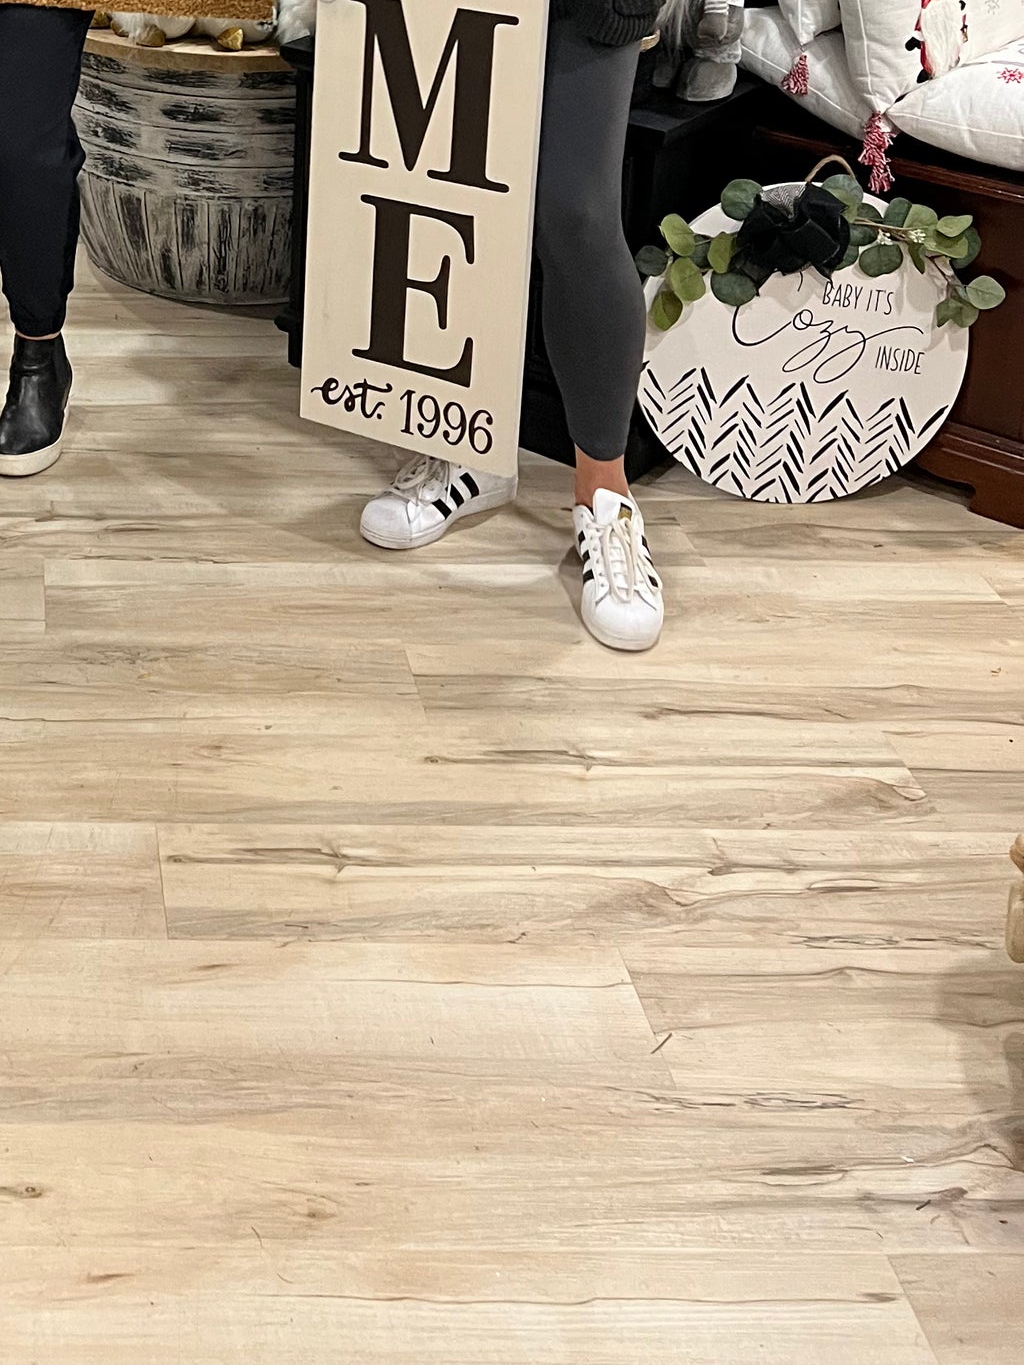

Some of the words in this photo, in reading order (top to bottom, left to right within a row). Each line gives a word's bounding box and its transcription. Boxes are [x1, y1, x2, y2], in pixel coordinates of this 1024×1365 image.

[822, 281, 864, 310] BABY
[874, 345, 926, 375] INSIDE
[310, 376, 394, 421] est.
[400, 388, 495, 456] 1996
